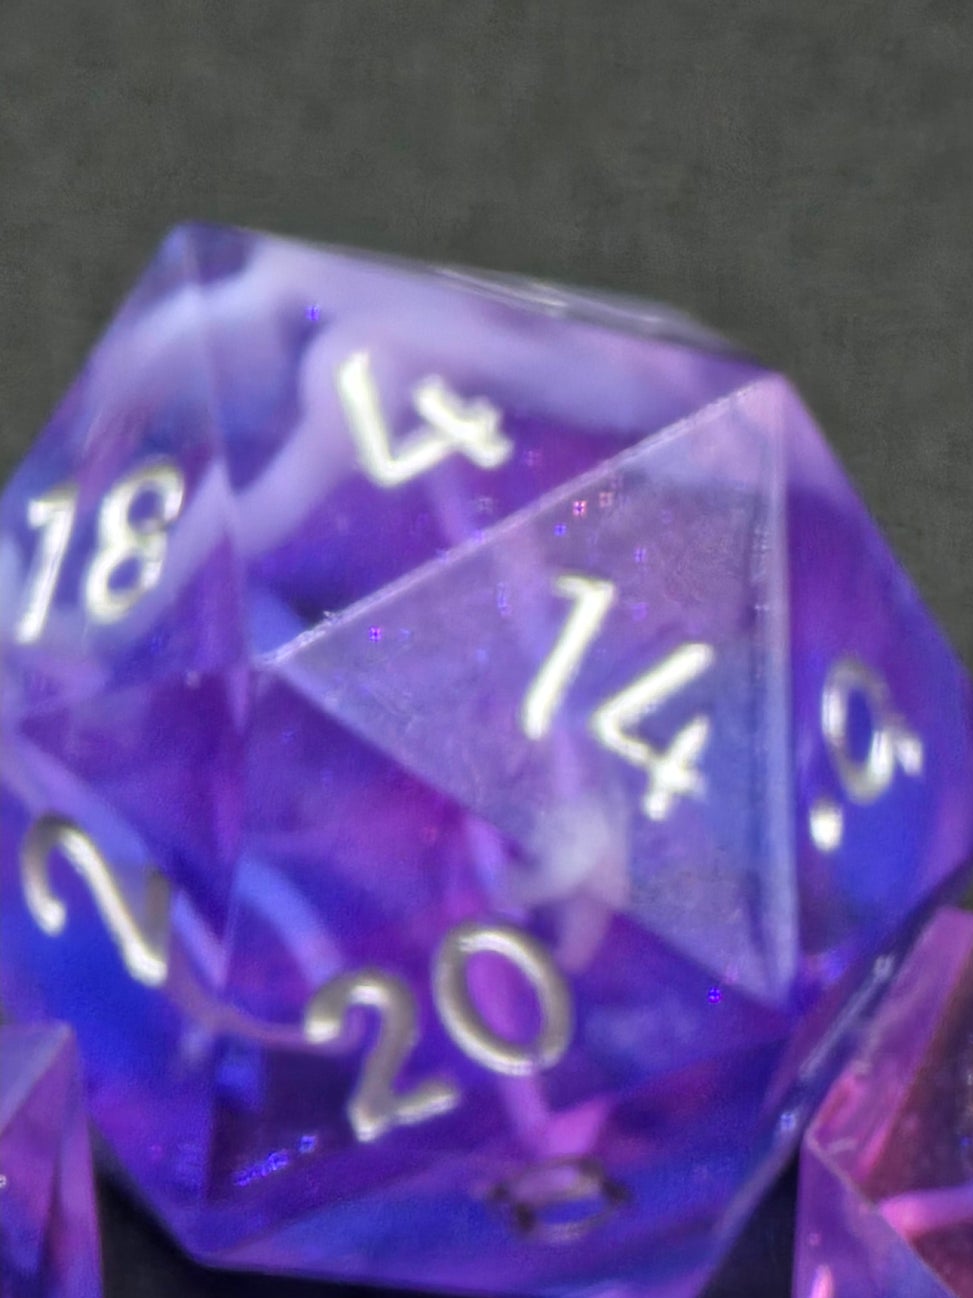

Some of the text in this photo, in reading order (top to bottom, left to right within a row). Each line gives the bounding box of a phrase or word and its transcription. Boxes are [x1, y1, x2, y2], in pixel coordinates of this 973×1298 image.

[337, 352, 514, 487] 4
[14, 456, 187, 645] 18
[519, 574, 716, 820] 14
[302, 920, 573, 1142] 20
